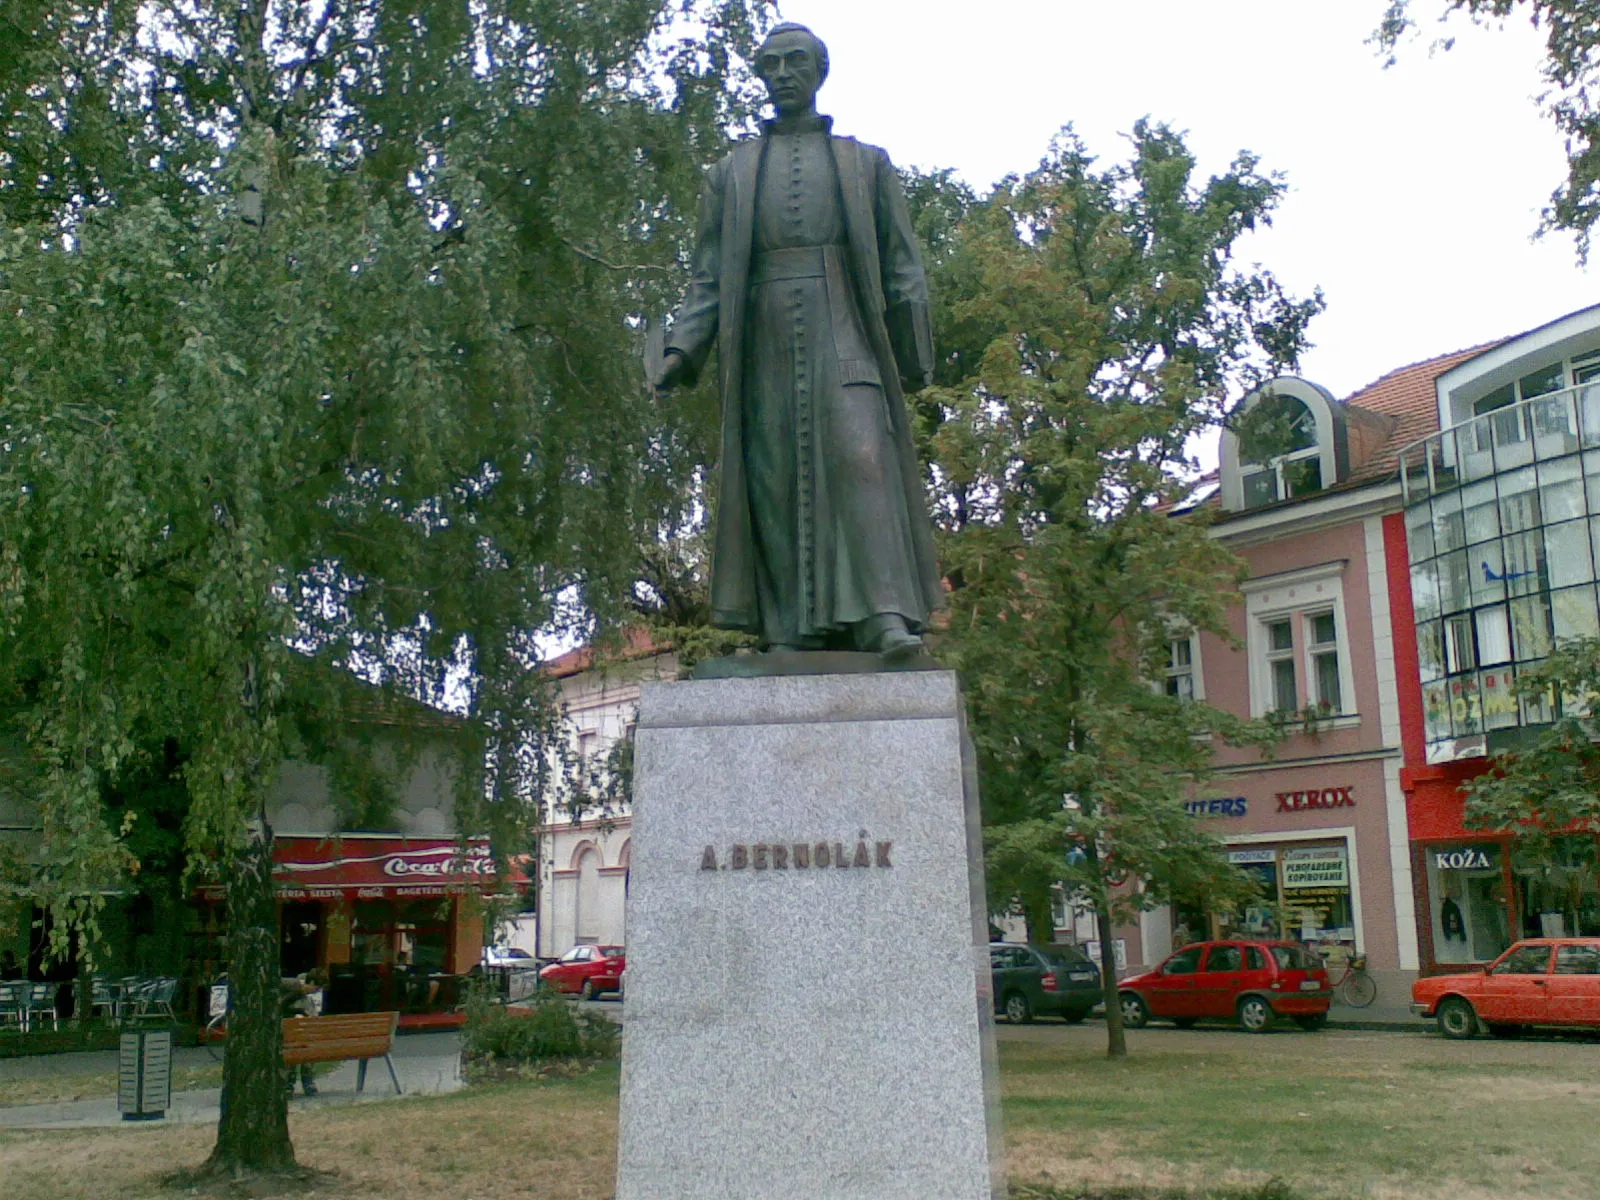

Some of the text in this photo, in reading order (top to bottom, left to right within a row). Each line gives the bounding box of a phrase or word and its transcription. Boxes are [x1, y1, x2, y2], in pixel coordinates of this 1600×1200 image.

[1274, 786, 1357, 813] XEROX
[699, 829, 894, 871] A.BERNOLÁK
[1435, 847, 1490, 869] KOŽA
